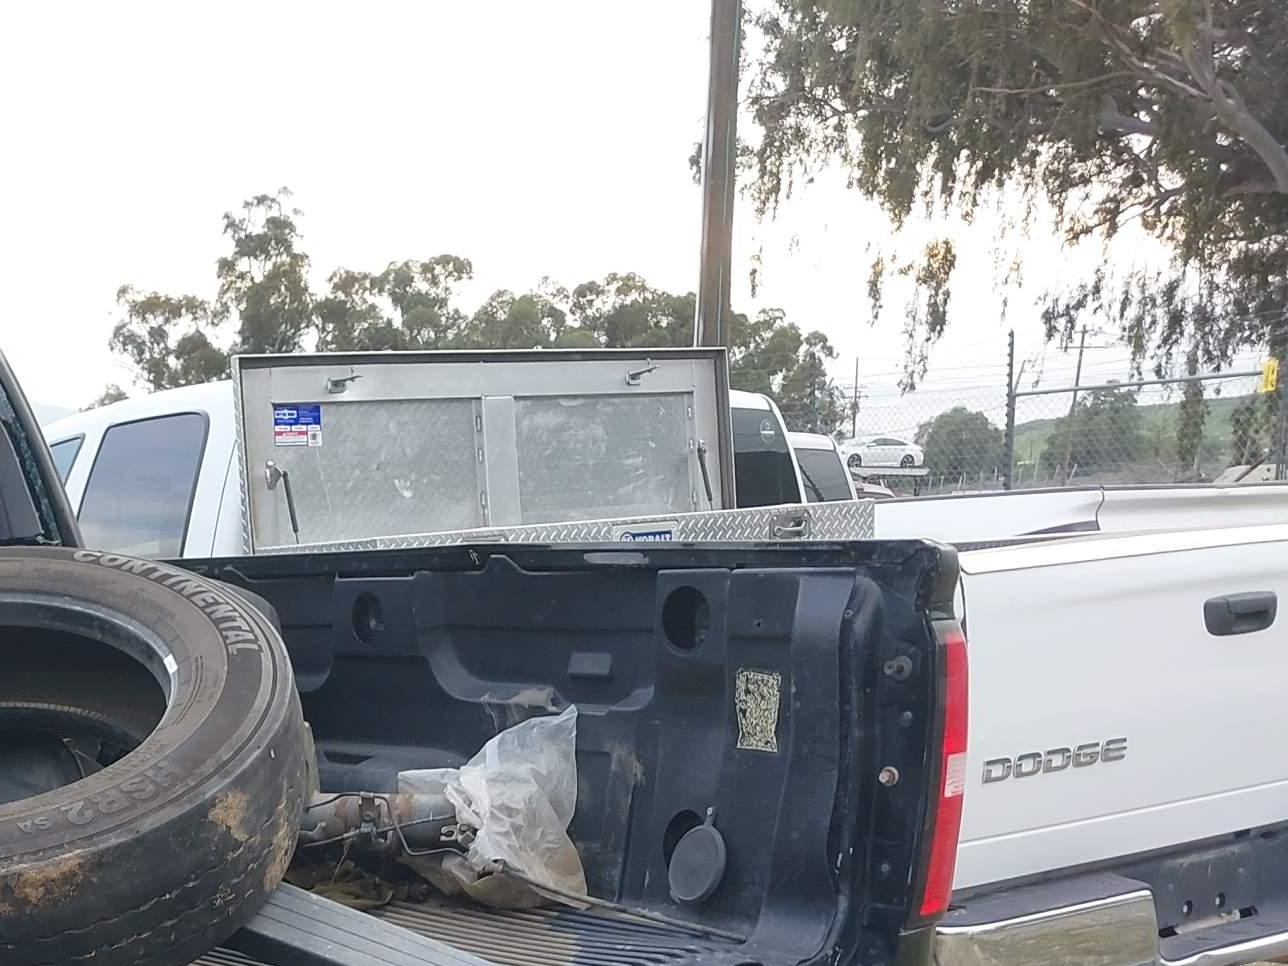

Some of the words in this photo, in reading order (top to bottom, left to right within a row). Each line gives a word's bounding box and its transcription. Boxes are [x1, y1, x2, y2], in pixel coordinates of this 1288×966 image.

[73, 550, 261, 656] CONTINENTAL
[982, 737, 1127, 784] DODGE
[16, 816, 52, 834] SA
